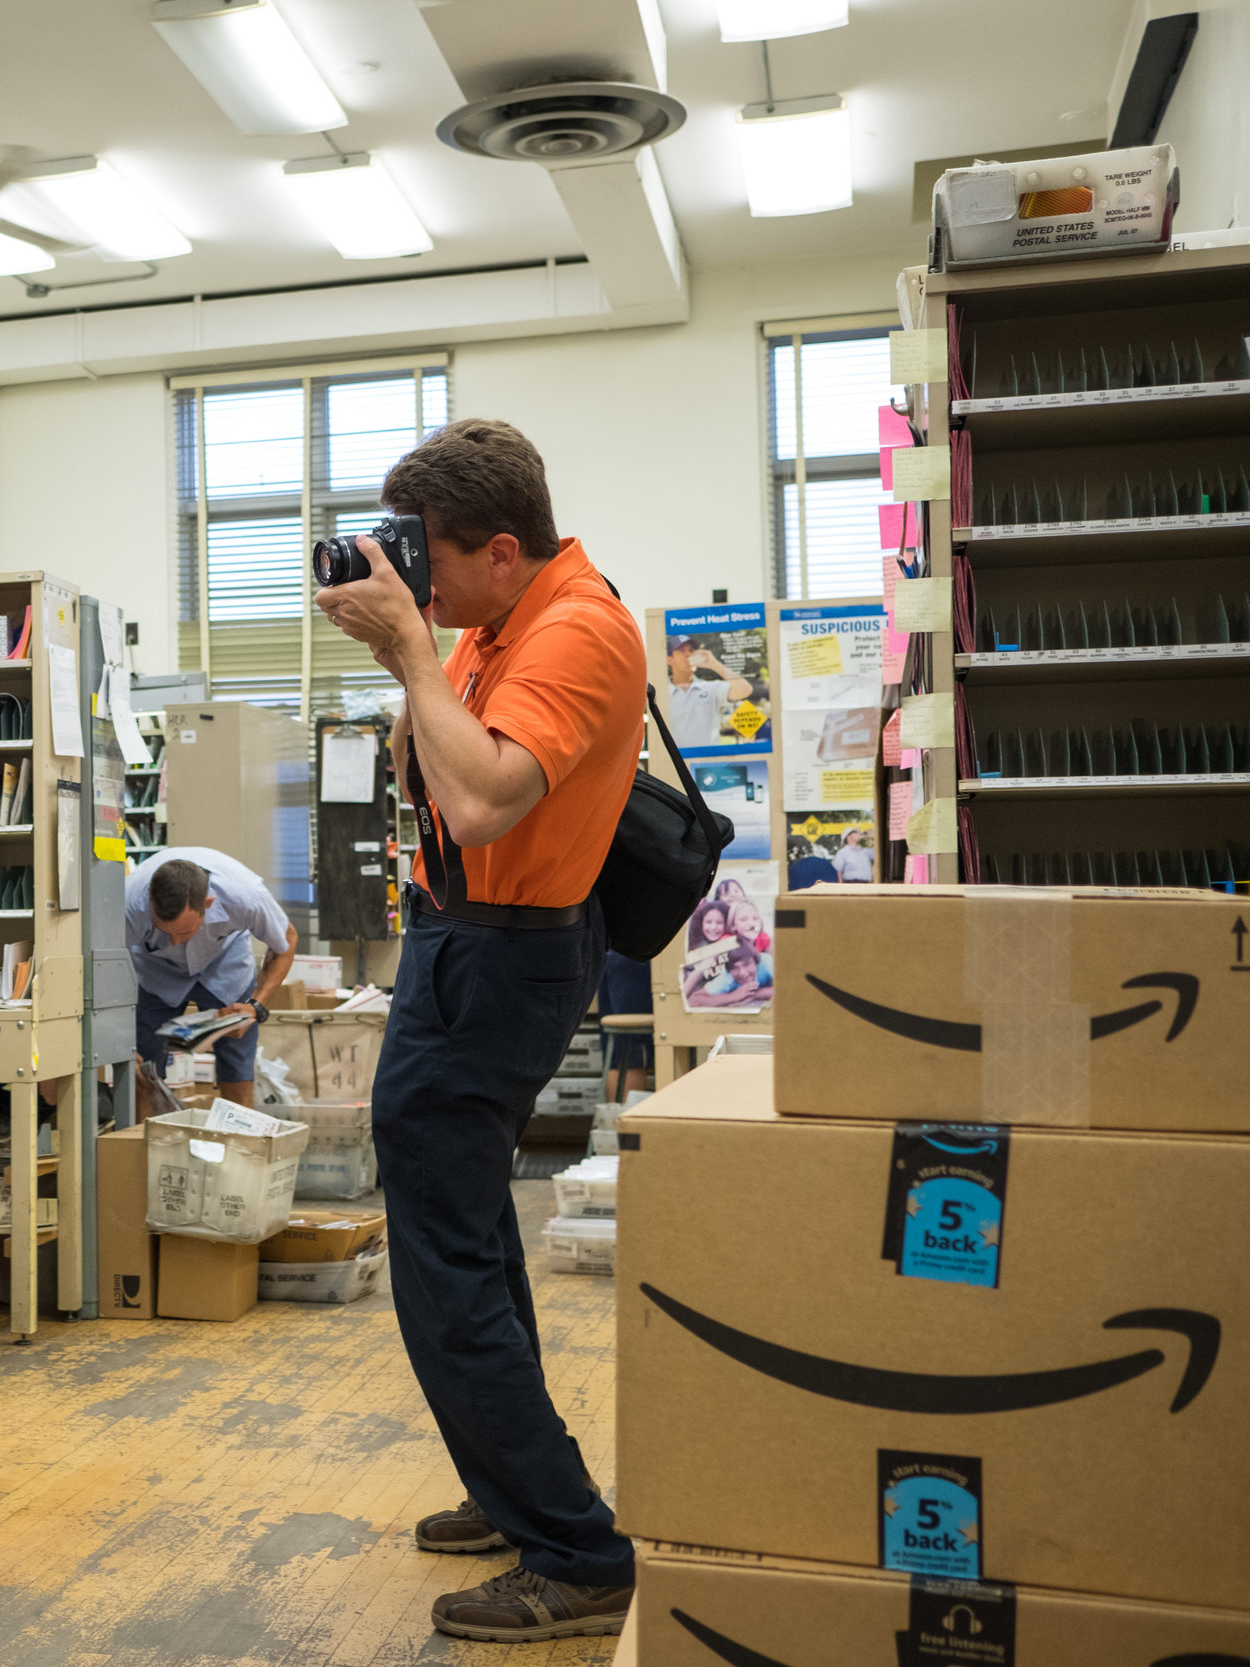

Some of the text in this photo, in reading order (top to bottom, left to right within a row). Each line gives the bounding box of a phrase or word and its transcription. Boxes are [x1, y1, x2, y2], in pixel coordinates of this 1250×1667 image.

[1105, 169, 1152, 181] TARE WEIGHT
[1017, 222, 1095, 237] UNITED STATES
[1013, 232, 1099, 247] POSTAL SERVICE
[670, 612, 761, 627] Prevent Heat Stress
[801, 620, 880, 636] SUSPICIOUS
[419, 806, 431, 836] EOS
[918, 1165, 995, 1190] start earning
[283, 1230, 317, 1242] SERVICE
[923, 1230, 978, 1254] back
[921, 1251, 970, 1264] Amazon.com
[971, 1258, 989, 1266] with
[920, 1260, 943, 1270] Prime
[944, 1262, 966, 1272] credit
[967, 1265, 986, 1275] card
[277, 1273, 317, 1283] SERVICE
[892, 1463, 969, 1487] start earning
[904, 1529, 959, 1553] back
[903, 1551, 952, 1562] Amazon.com
[953, 1556, 972, 1564] with
[901, 1559, 925, 1570] Prime
[926, 1561, 949, 1572] credit
[949, 1565, 968, 1573] card
[920, 1632, 1004, 1656] free listening
